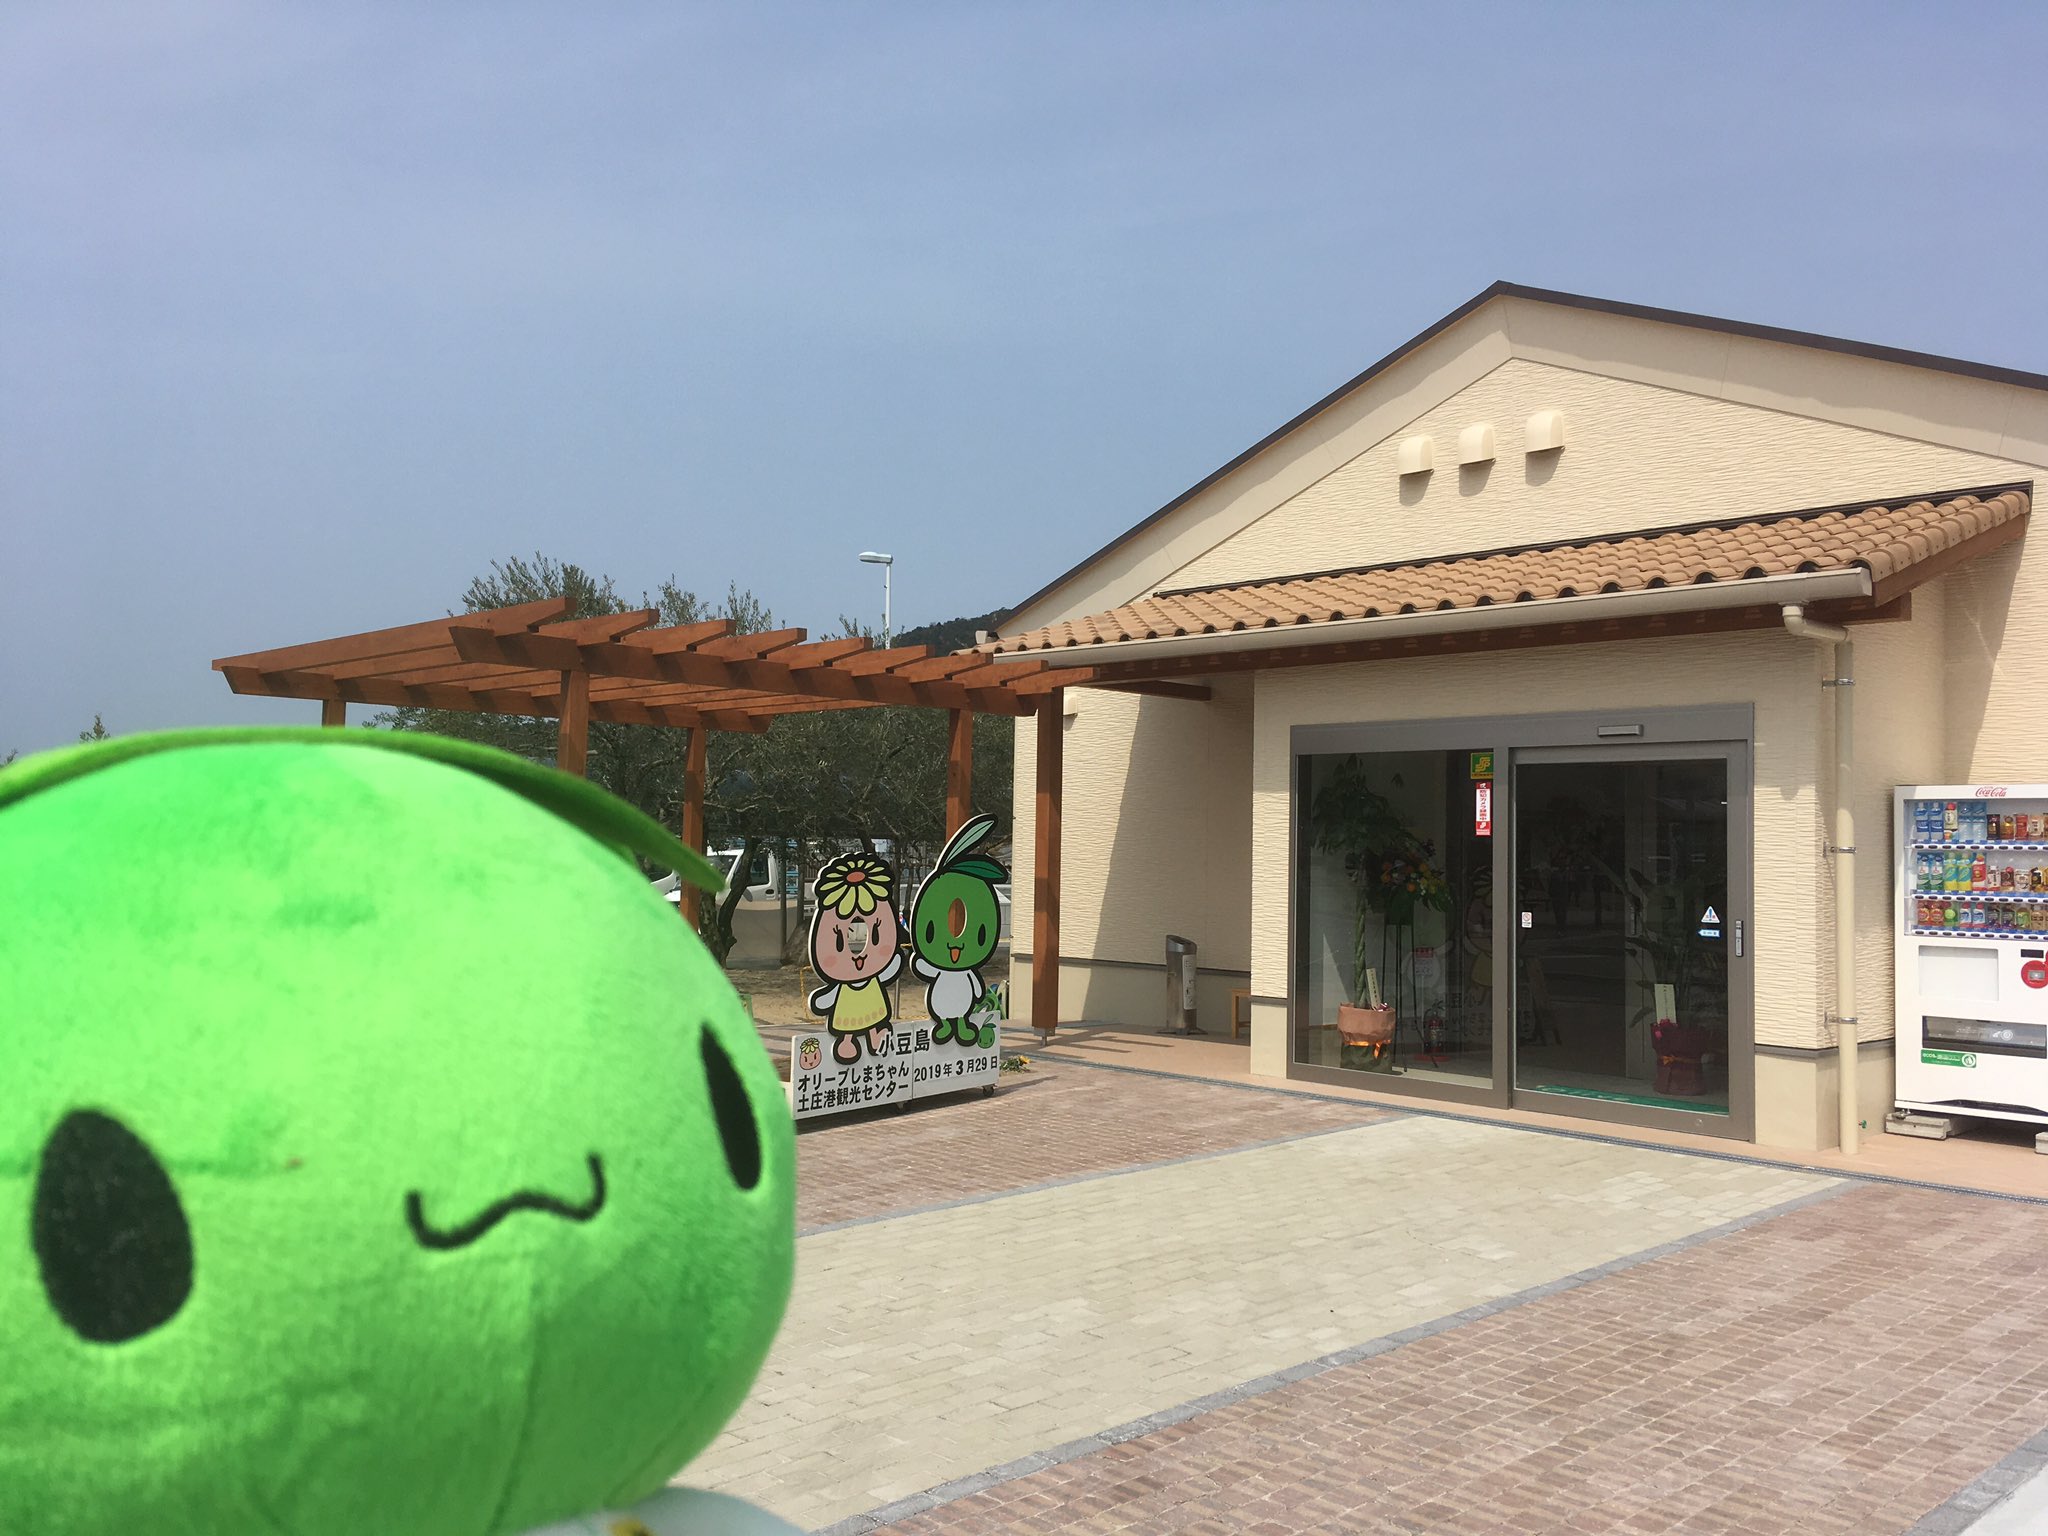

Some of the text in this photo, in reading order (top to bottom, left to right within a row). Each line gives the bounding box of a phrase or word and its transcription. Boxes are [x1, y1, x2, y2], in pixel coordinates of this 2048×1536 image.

[879, 1028, 931, 1058] 小豆島
[798, 1060, 909, 1092] オリーブしまちゃん
[797, 1080, 909, 1112] 土庄港観光センター
